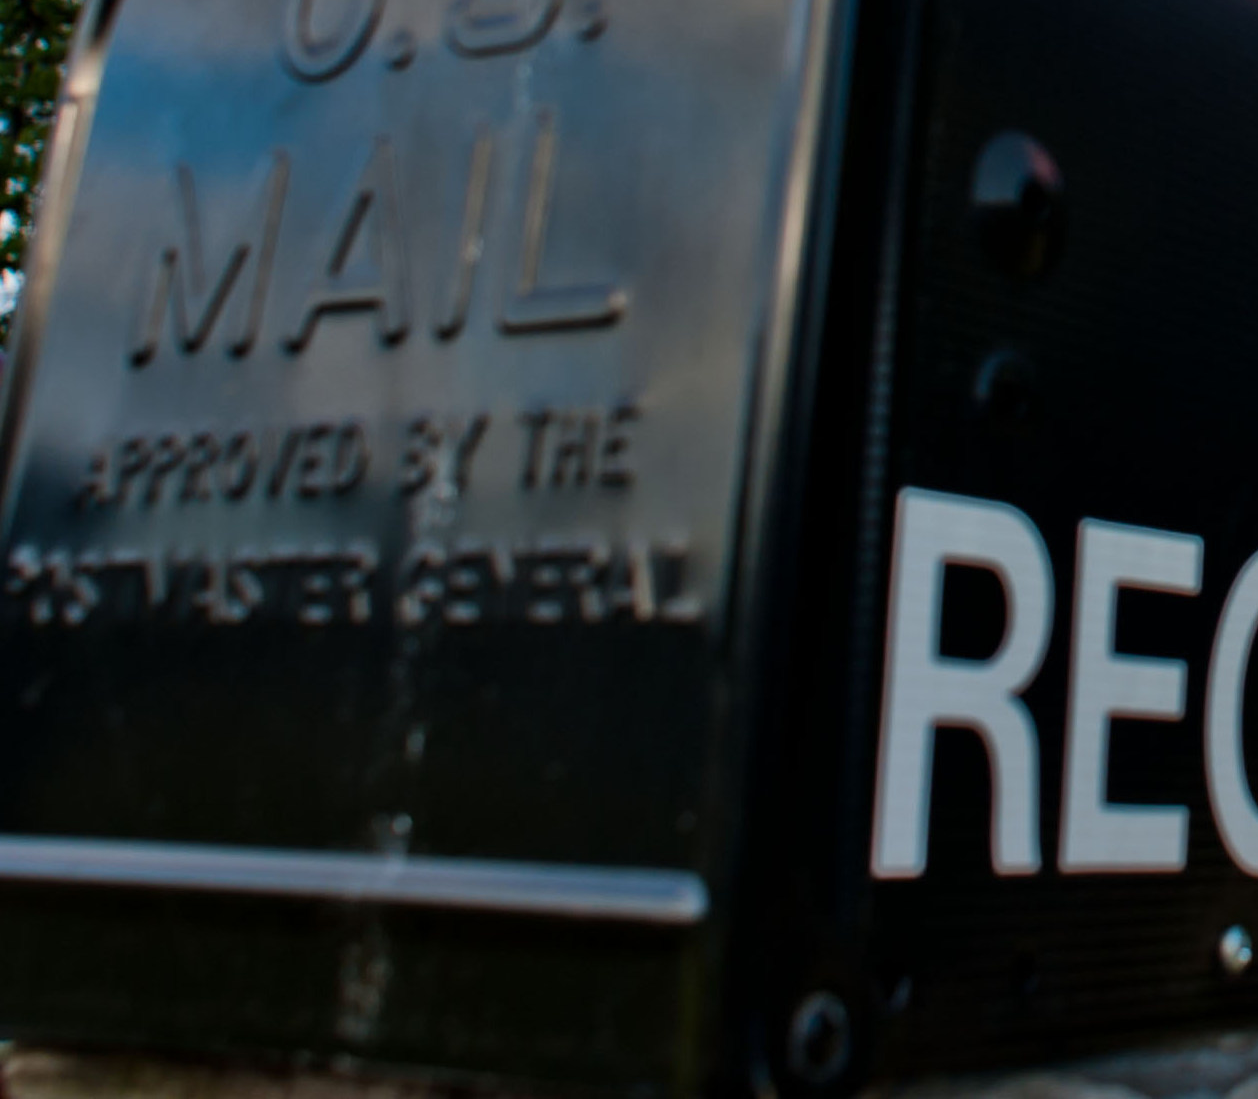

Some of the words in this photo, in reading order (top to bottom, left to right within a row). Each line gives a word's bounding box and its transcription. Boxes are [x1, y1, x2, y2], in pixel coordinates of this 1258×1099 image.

[131, 109, 630, 366] MAIL
[76, 423, 370, 507] APPROVED
[400, 412, 489, 495] BY
[519, 402, 641, 491] THE
[398, 535, 704, 623] GENERAL
